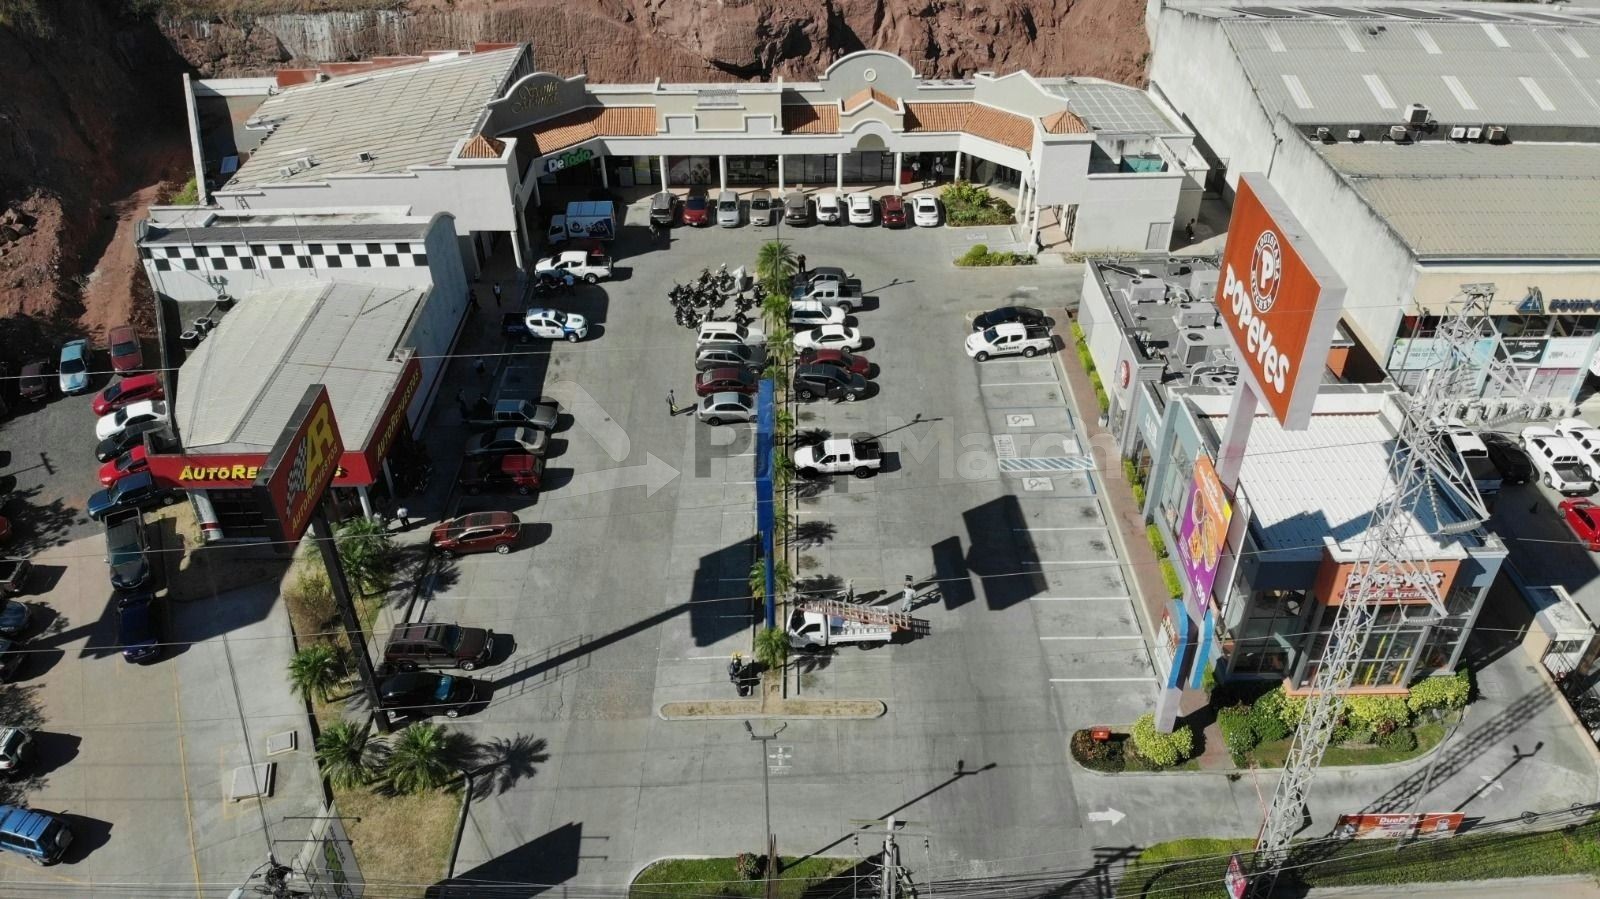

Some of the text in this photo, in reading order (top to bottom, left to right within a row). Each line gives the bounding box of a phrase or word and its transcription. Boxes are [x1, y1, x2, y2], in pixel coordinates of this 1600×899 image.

[548, 149, 591, 172] DeTodo
[1257, 232, 1280, 281] LOUISIANA
[1251, 270, 1273, 311] KITCHEN
